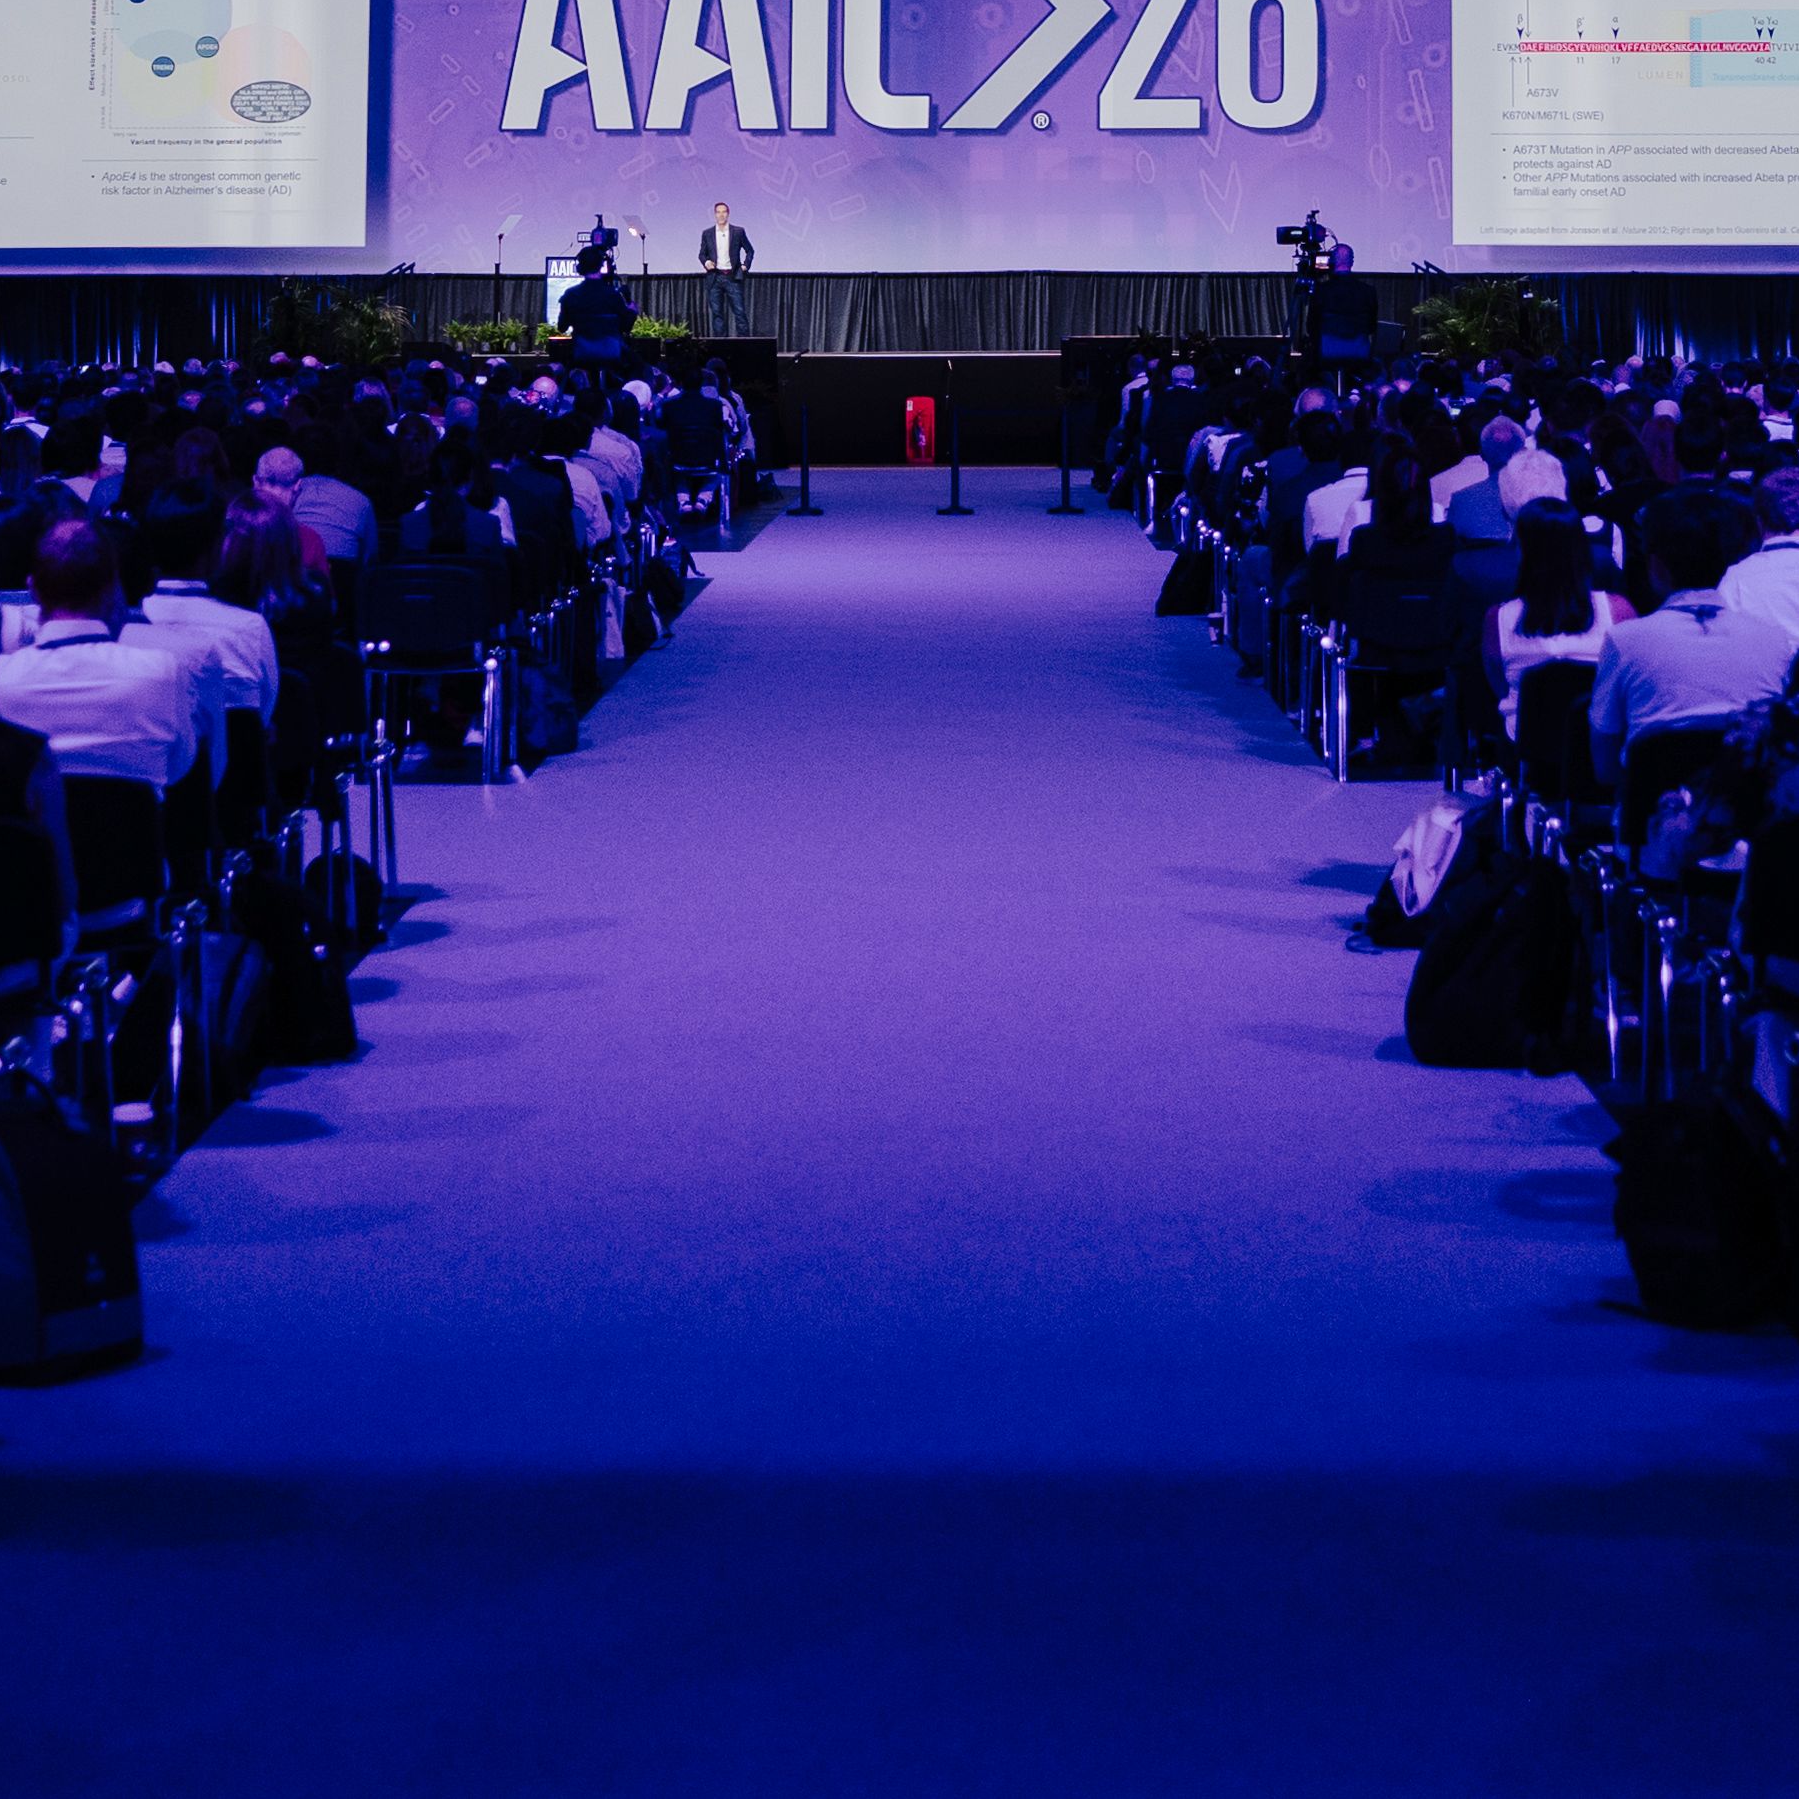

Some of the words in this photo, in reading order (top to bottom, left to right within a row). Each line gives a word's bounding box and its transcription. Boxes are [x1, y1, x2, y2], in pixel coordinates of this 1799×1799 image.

[1526, 88, 1559, 98] A673V
[1572, 111, 1604, 122] (SWE)
[1512, 144, 1547, 155] A673T
[1549, 145, 1593, 155] Mutation
[1596, 146, 1605, 155] in
[1608, 145, 1632, 155] APP
[1633, 145, 1688, 155] associated
[1690, 145, 1712, 155] with
[1714, 146, 1767, 155] decreased
[1769, 145, 1799, 155] Abeta
[1513, 160, 1554, 171] protects
[1556, 159, 1594, 171] against
[1595, 159, 1612, 169] AD
[101, 171, 136, 183] ApoE4
[139, 172, 148, 181] is
[150, 172, 166, 181] the
[169, 172, 215, 184] strongest
[218, 173, 262, 181] common
[264, 171, 301, 184] genetic
[1513, 172, 1542, 183] Other
[1544, 172, 1569, 182] APP
[1570, 173, 1620, 183] Mutations
[1622, 172, 1677, 183] associated
[1679, 172, 1701, 182] with
[1703, 173, 1753, 183] increased
[1754, 172, 1785, 182] Abeta
[101, 186, 119, 195] risk
[122, 185, 151, 195] factor
[153, 186, 163, 195] in
[226, 186, 266, 195] disease
[268, 185, 292, 197] (AD)
[1513, 186, 1549, 196] familial
[1552, 187, 1577, 199] early
[1580, 187, 1608, 197] onset
[1610, 186, 1626, 197] AD
